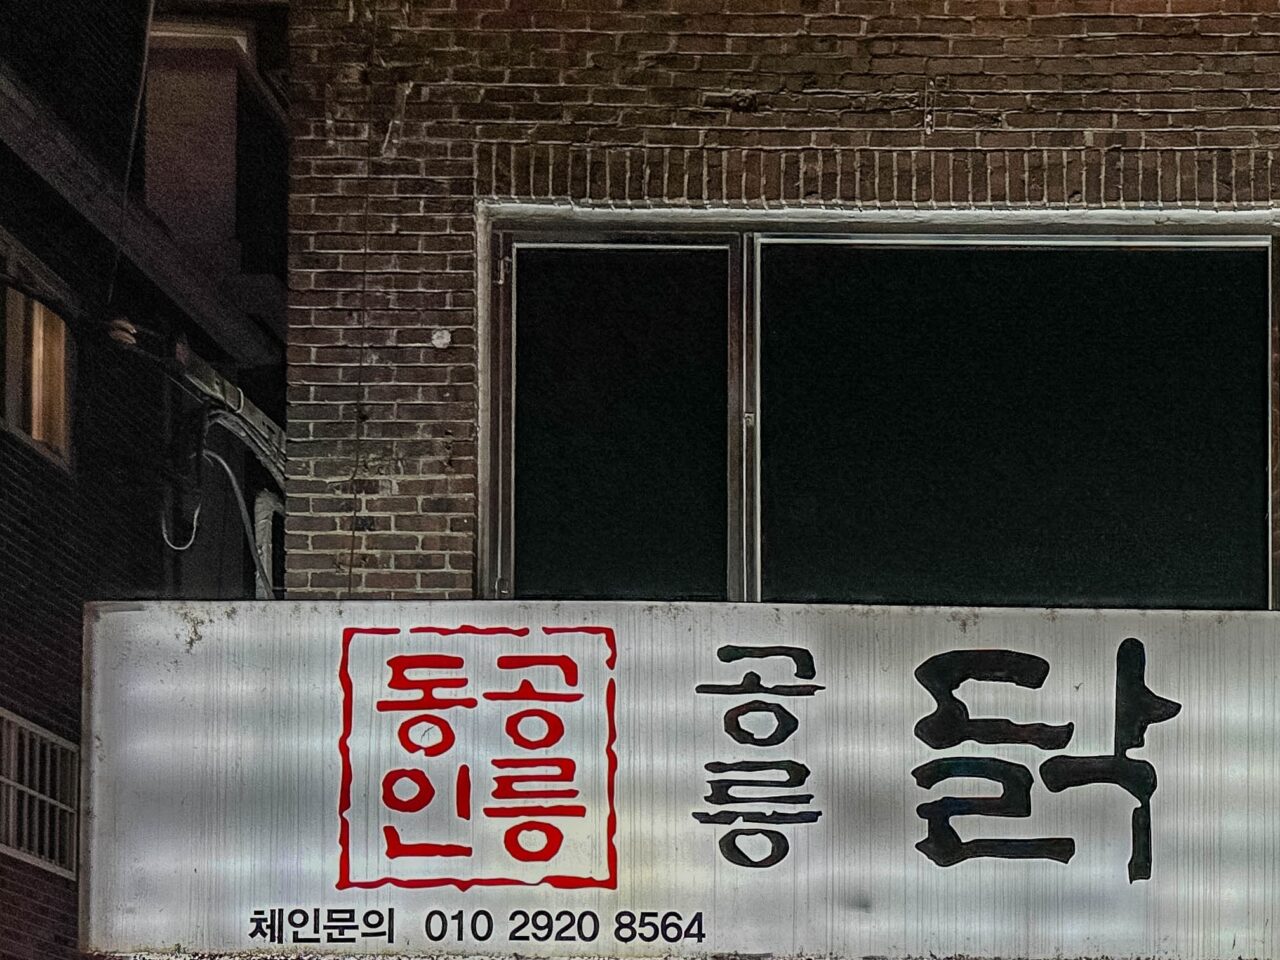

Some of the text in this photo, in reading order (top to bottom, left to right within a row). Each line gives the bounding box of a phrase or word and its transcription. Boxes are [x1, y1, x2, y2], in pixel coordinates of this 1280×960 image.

[691, 644, 826, 868] 공릉
[249, 907, 708, 944] 체인문의 010 2920 8564
